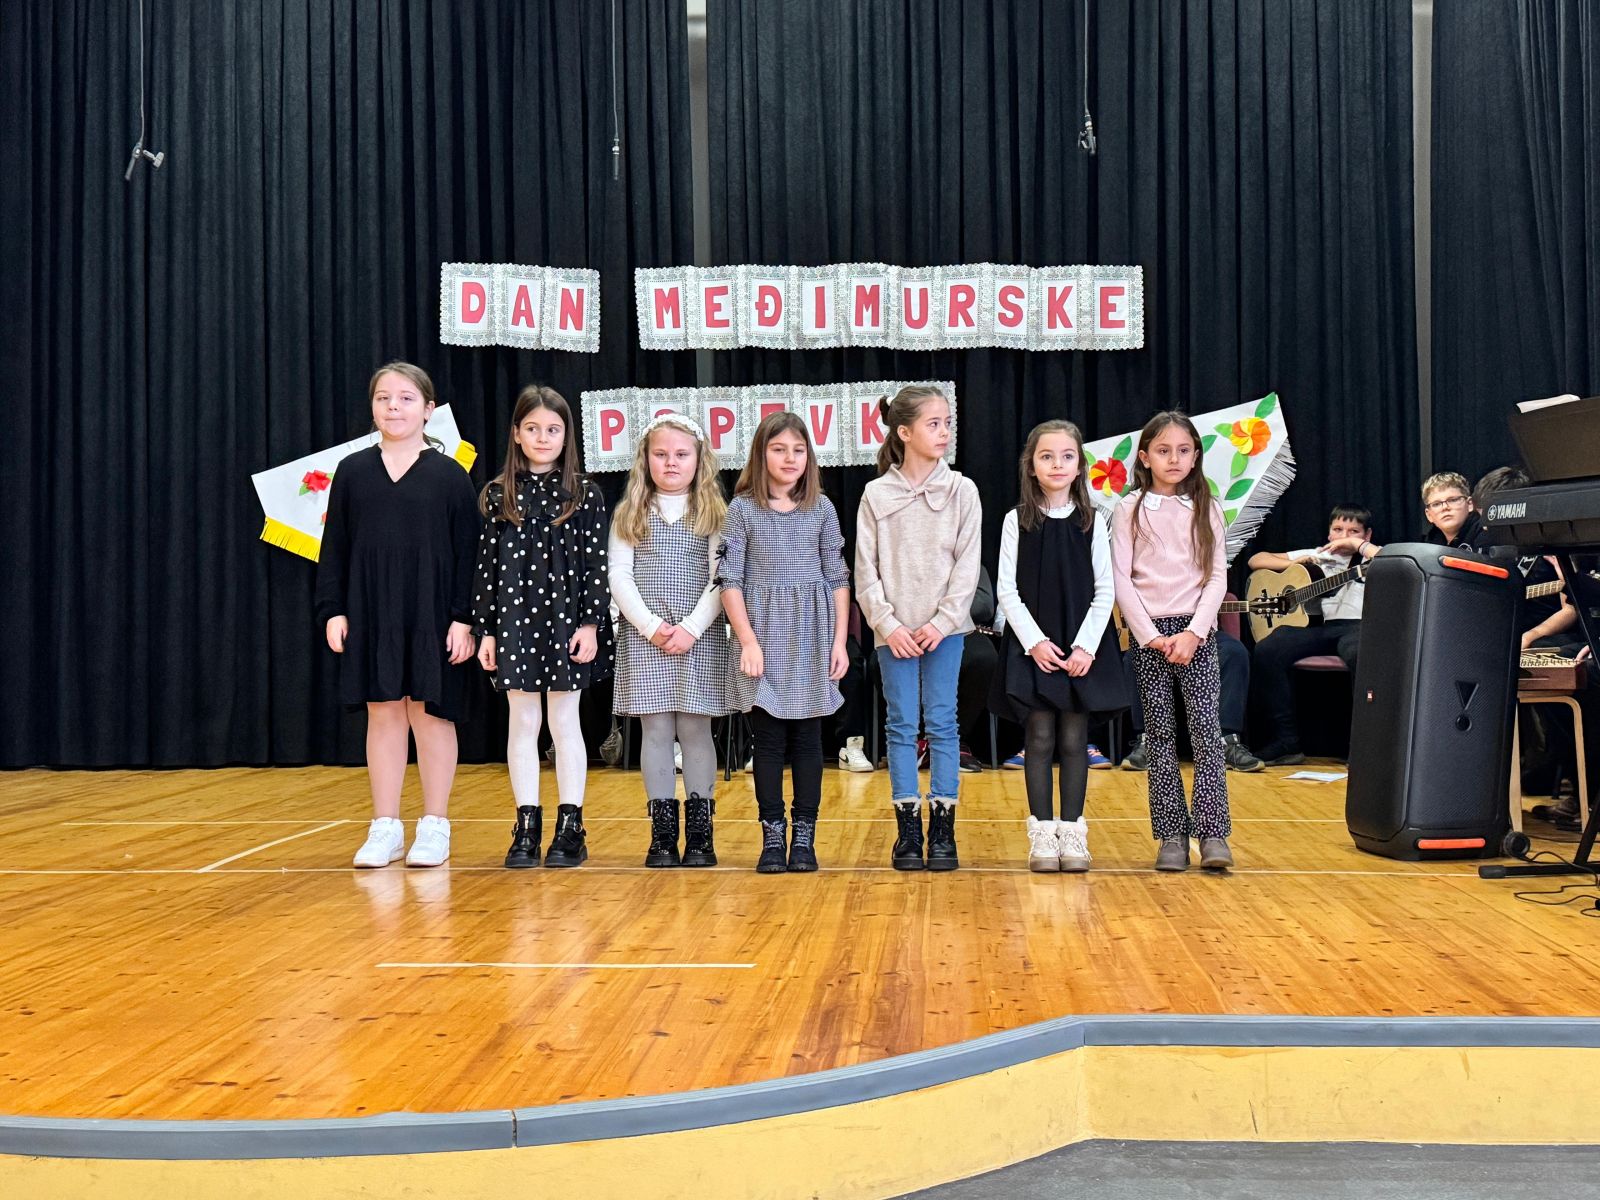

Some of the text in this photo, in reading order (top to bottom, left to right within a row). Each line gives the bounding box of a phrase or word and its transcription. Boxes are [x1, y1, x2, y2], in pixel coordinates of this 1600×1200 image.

[461, 281, 1126, 332] DAN MEĐIMURSKE
[599, 403, 886, 452] PPVK
[1496, 502, 1527, 520] YAMAHA
